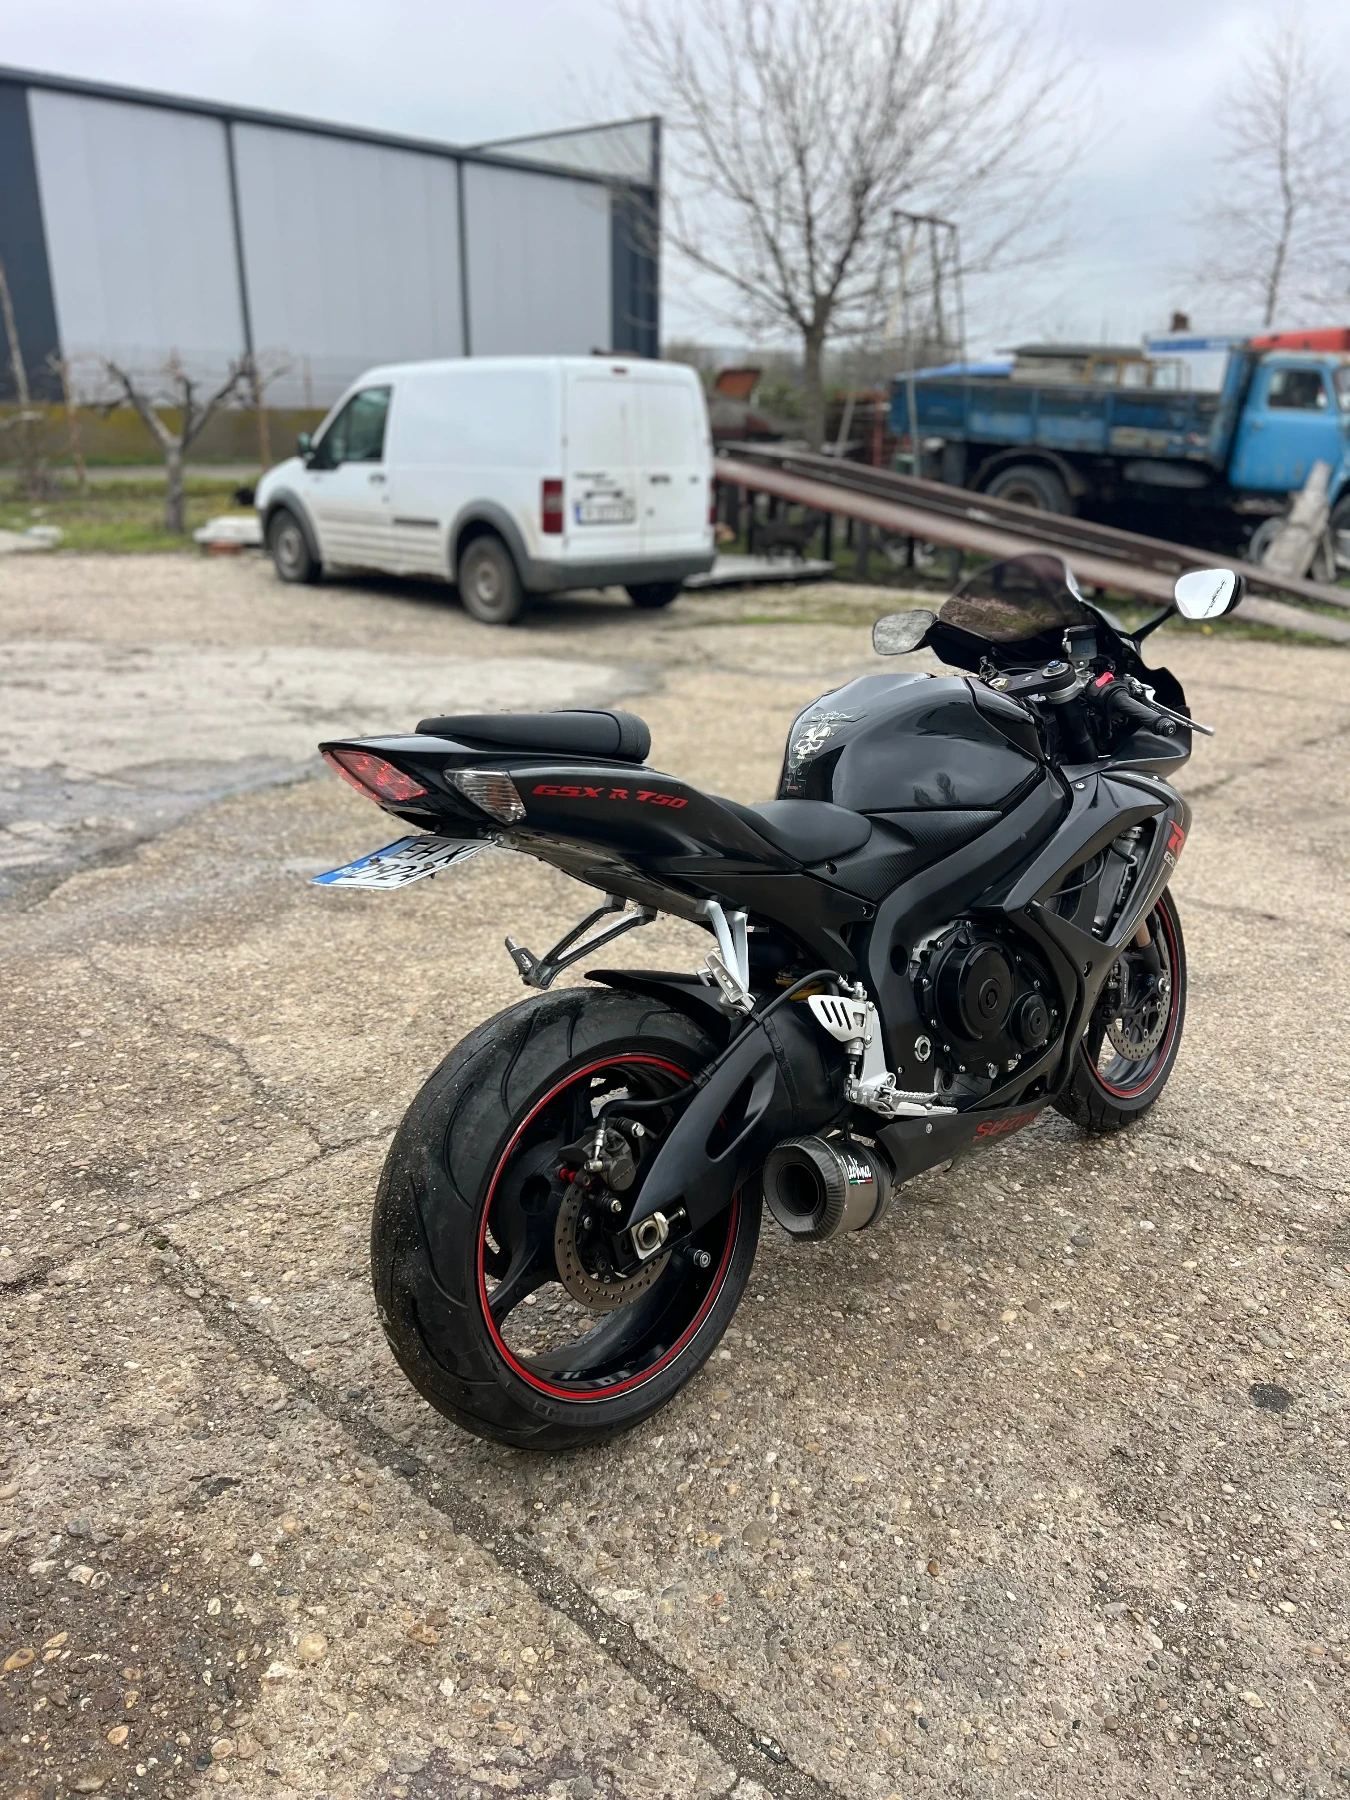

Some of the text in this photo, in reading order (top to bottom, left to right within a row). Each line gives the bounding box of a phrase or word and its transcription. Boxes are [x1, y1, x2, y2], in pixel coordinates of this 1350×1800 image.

[532, 784, 689, 809] GSX R 750
[391, 842, 452, 861] EH
